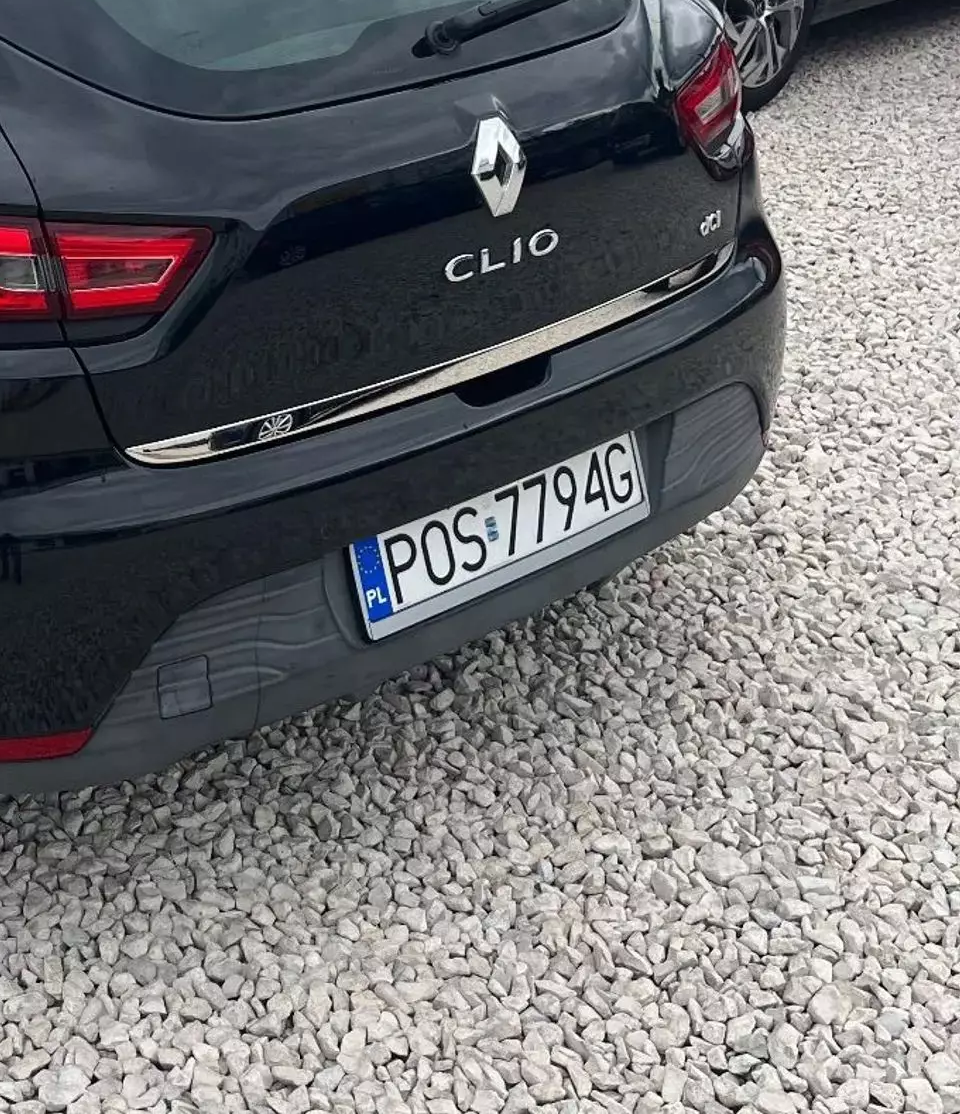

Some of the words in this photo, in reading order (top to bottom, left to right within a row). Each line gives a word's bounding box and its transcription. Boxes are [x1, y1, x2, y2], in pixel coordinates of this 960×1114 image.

[444, 229, 559, 282] CLIO
[384, 506, 488, 604] POS
[494, 442, 634, 557] 7794G
[366, 587, 387, 608] PL
